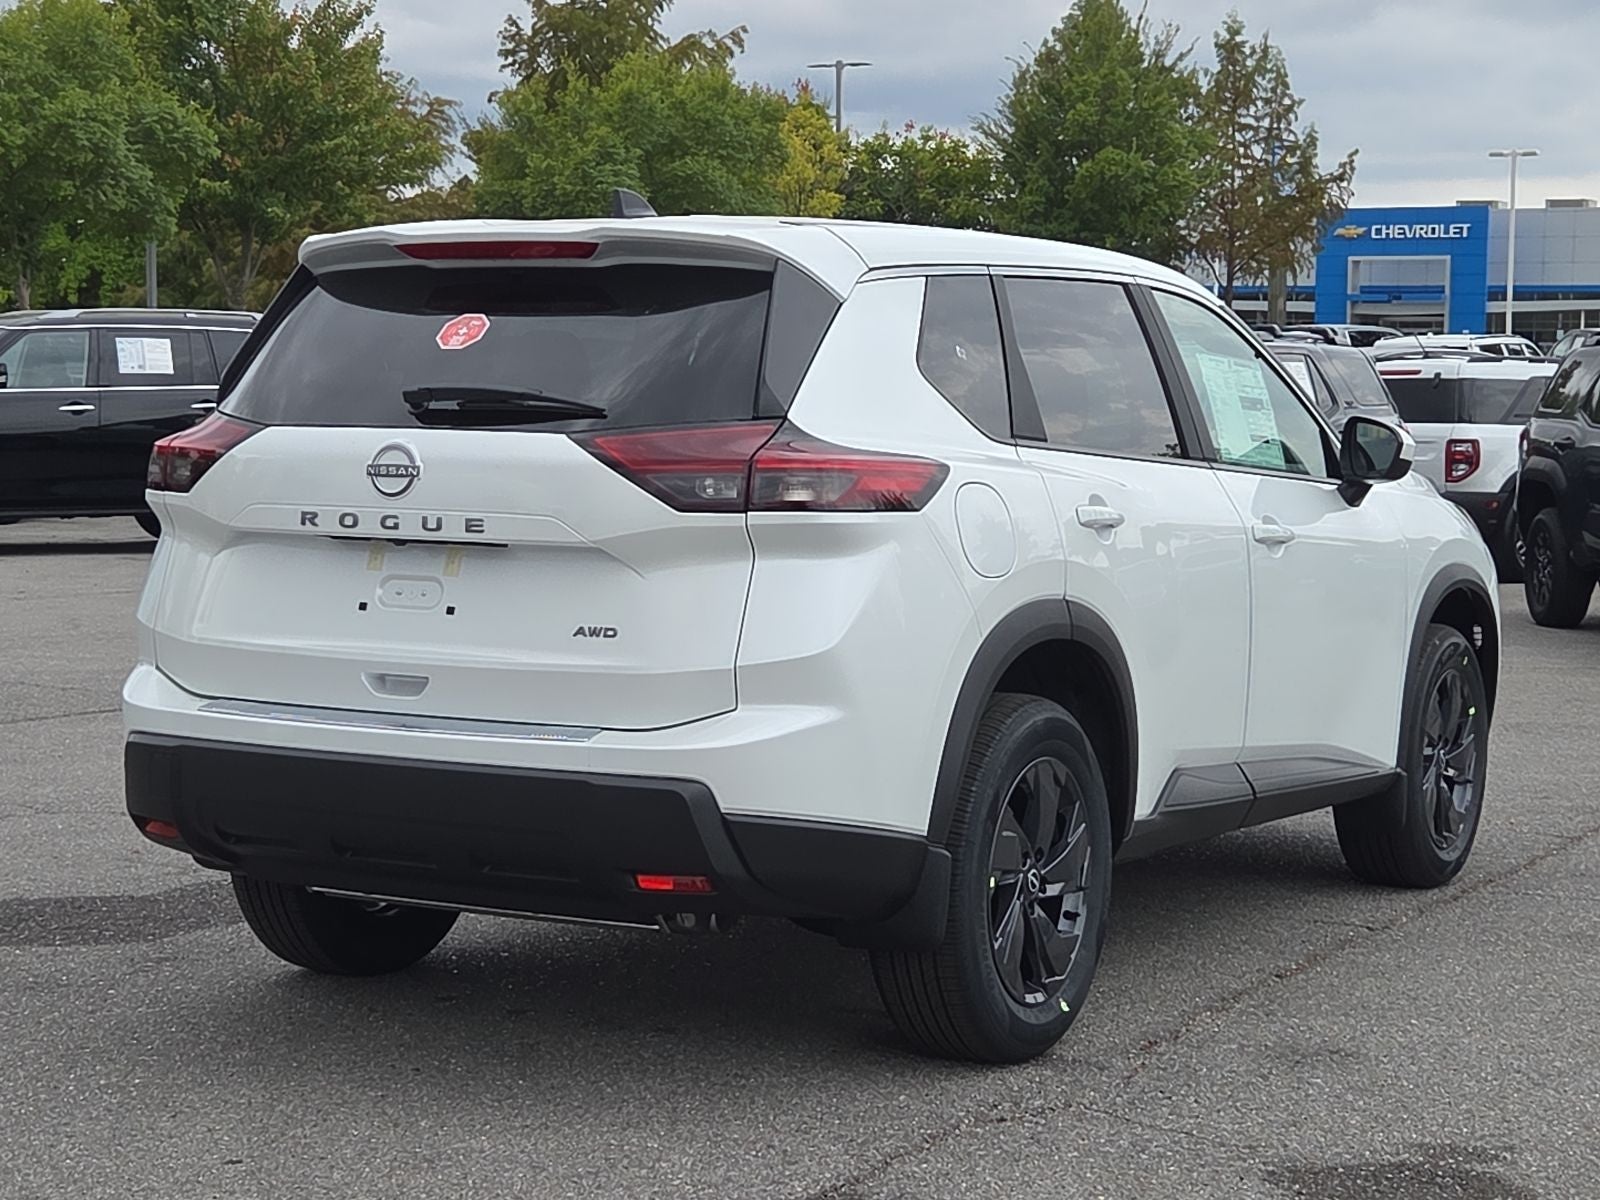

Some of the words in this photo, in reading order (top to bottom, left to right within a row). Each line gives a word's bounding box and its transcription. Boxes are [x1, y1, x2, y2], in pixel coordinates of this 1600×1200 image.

[1371, 223, 1471, 239] CHEVROLET
[367, 465, 418, 477] NISSAN
[300, 511, 485, 533] ROGUE
[572, 626, 618, 639] AWD
